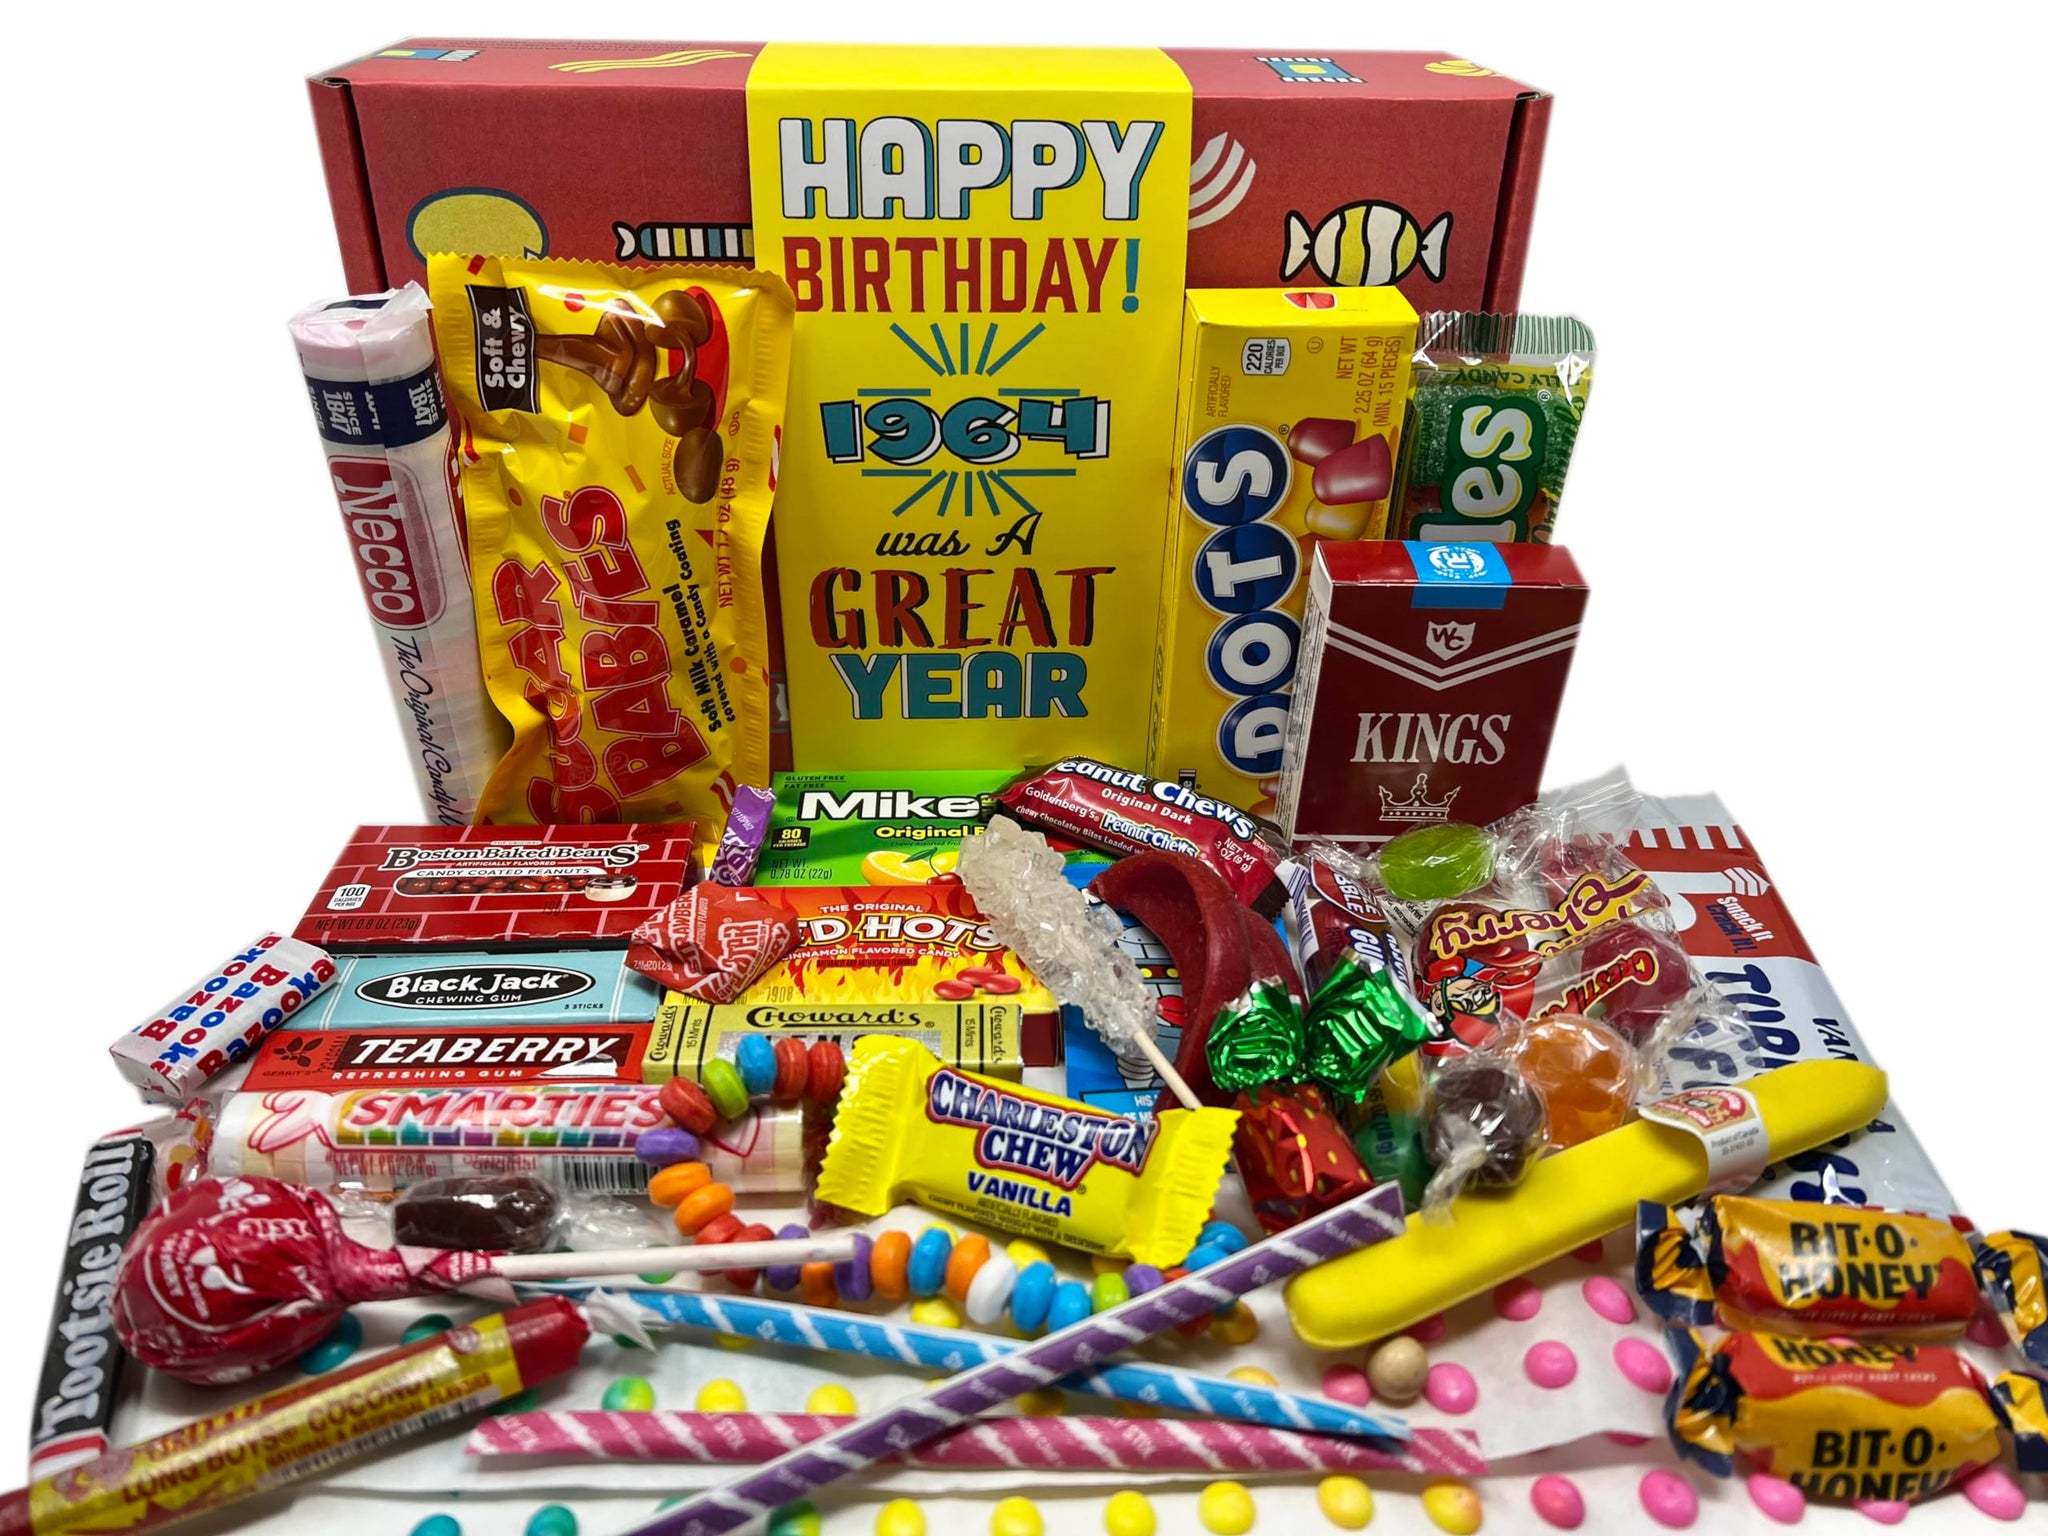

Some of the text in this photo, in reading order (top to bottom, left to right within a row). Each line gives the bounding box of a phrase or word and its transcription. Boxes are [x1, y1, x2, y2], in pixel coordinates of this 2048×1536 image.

[778, 116, 1166, 220] HAPPY
[782, 236, 1141, 313] BIRTHDAY!
[481, 301, 505, 390] Soft &
[504, 304, 530, 391] Chewy
[1246, 342, 1264, 372] 220
[1263, 339, 1277, 376] CALORIES
[1274, 345, 1287, 370] PER BOX
[1336, 336, 1358, 379] NET WT
[1205, 365, 1222, 418] ARTIFICIALLY
[1354, 336, 1384, 413] 2.25 OZ (64 g)
[1373, 336, 1406, 427] (MIN. 15 PIECES)
[1453, 367, 1526, 385] CANDY
[322, 389, 352, 436] 1847
[342, 391, 363, 436] SINCE
[408, 383, 434, 428] 1847
[424, 377, 440, 424] SINCE
[1217, 376, 1232, 418] FLAVORED
[820, 396, 1111, 466] 1964
[660, 437, 677, 496] ACTUAL SIZE
[719, 477, 737, 500] (48
[718, 502, 732, 523] OZ
[875, 512, 1043, 556] was A
[333, 474, 416, 618] Necco
[717, 556, 732, 579] WT
[718, 587, 734, 608] NET
[809, 566, 1117, 650] GREAT
[1194, 449, 1292, 760] DOTS
[391, 634, 423, 670] The
[541, 485, 711, 799] BABIES
[702, 628, 712, 640] a
[662, 582, 722, 733] Soft Milk Caramel
[703, 641, 720, 672] with
[829, 651, 1089, 719] YEAR
[399, 668, 445, 752] Original
[1350, 711, 1511, 766] KINGS
[421, 749, 458, 810] Candy
[1056, 761, 1257, 840] eanut Chews
[798, 790, 982, 820] Mike
[1025, 786, 1096, 818] Goldenberg's
[1101, 788, 1193, 826] Original Dark
[781, 828, 802, 839] 80
[875, 825, 969, 840] Original
[1015, 805, 1133, 852] Chewy Chocolatey Bites Loaded
[1102, 812, 1197, 858] Peanut Chews
[379, 847, 483, 871] Boston
[484, 845, 551, 859] Baked
[416, 867, 591, 877] CANDY COATED PEANUTS
[1220, 848, 1235, 861] OZ
[1223, 837, 1259, 865] NET WT
[340, 886, 366, 898] 100
[770, 868, 833, 880] 0.78 OZ (22g)
[1333, 871, 1365, 914] BBLE
[315, 918, 421, 931] NET WT 0.8 OZ (23g)
[819, 903, 924, 913] THE ORIGINAL
[1434, 873, 1650, 955] Cherry
[1704, 903, 1745, 937] Crack
[1716, 895, 1775, 942] Smack It
[851, 946, 915, 955] FLAVORED
[918, 948, 961, 959] CANDY
[863, 915, 1002, 947] HOTS
[139, 935, 284, 1042] Bazooka
[385, 972, 561, 999] Black Jack
[415, 994, 522, 1005] CHEWING GUM
[150, 964, 290, 1077] Bazooka
[196, 958, 336, 1078] Bazooka
[686, 1017, 702, 1049] 15 Mints
[964, 1026, 975, 1048] Mints
[350, 1037, 621, 1065] TEABERRY
[331, 1069, 524, 1080] REFRESHING GUM
[349, 1091, 668, 1129] SMARTIES
[930, 1069, 1157, 1169] CHARLESTON
[981, 1127, 1090, 1184] CHEW
[968, 1170, 1073, 1218] VANILLA
[35, 1140, 136, 1439] Tootsie Roll
[1779, 1262, 1937, 1300] HONEY
[122, 1465, 197, 1504] LONG
[306, 1376, 437, 1435] COCONUT
